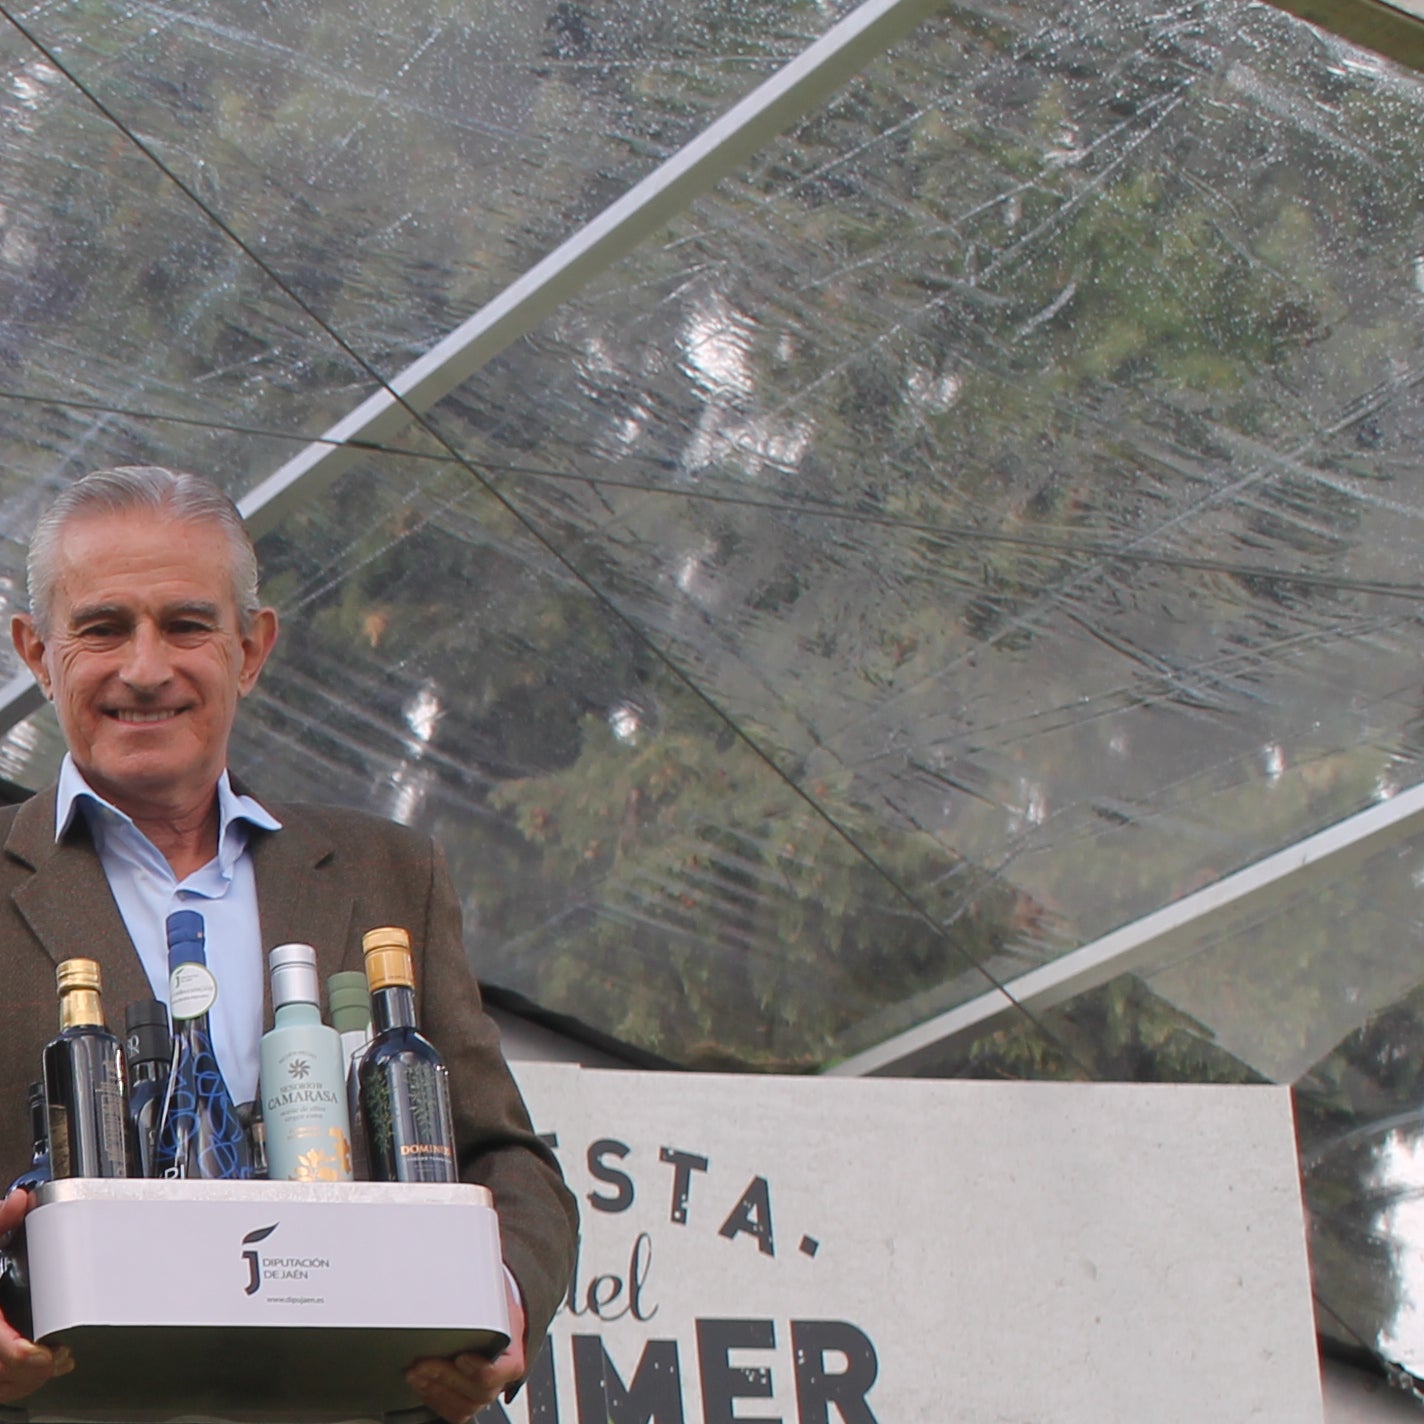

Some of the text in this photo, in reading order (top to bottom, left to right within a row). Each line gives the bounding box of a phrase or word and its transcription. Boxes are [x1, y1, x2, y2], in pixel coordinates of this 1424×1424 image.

[267, 1090, 338, 1111] CAMARASA
[542, 1131, 820, 1259] STA.
[262, 1257, 330, 1269] DIPUTACIÓN
[263, 1269, 309, 1280] DE JAÉN
